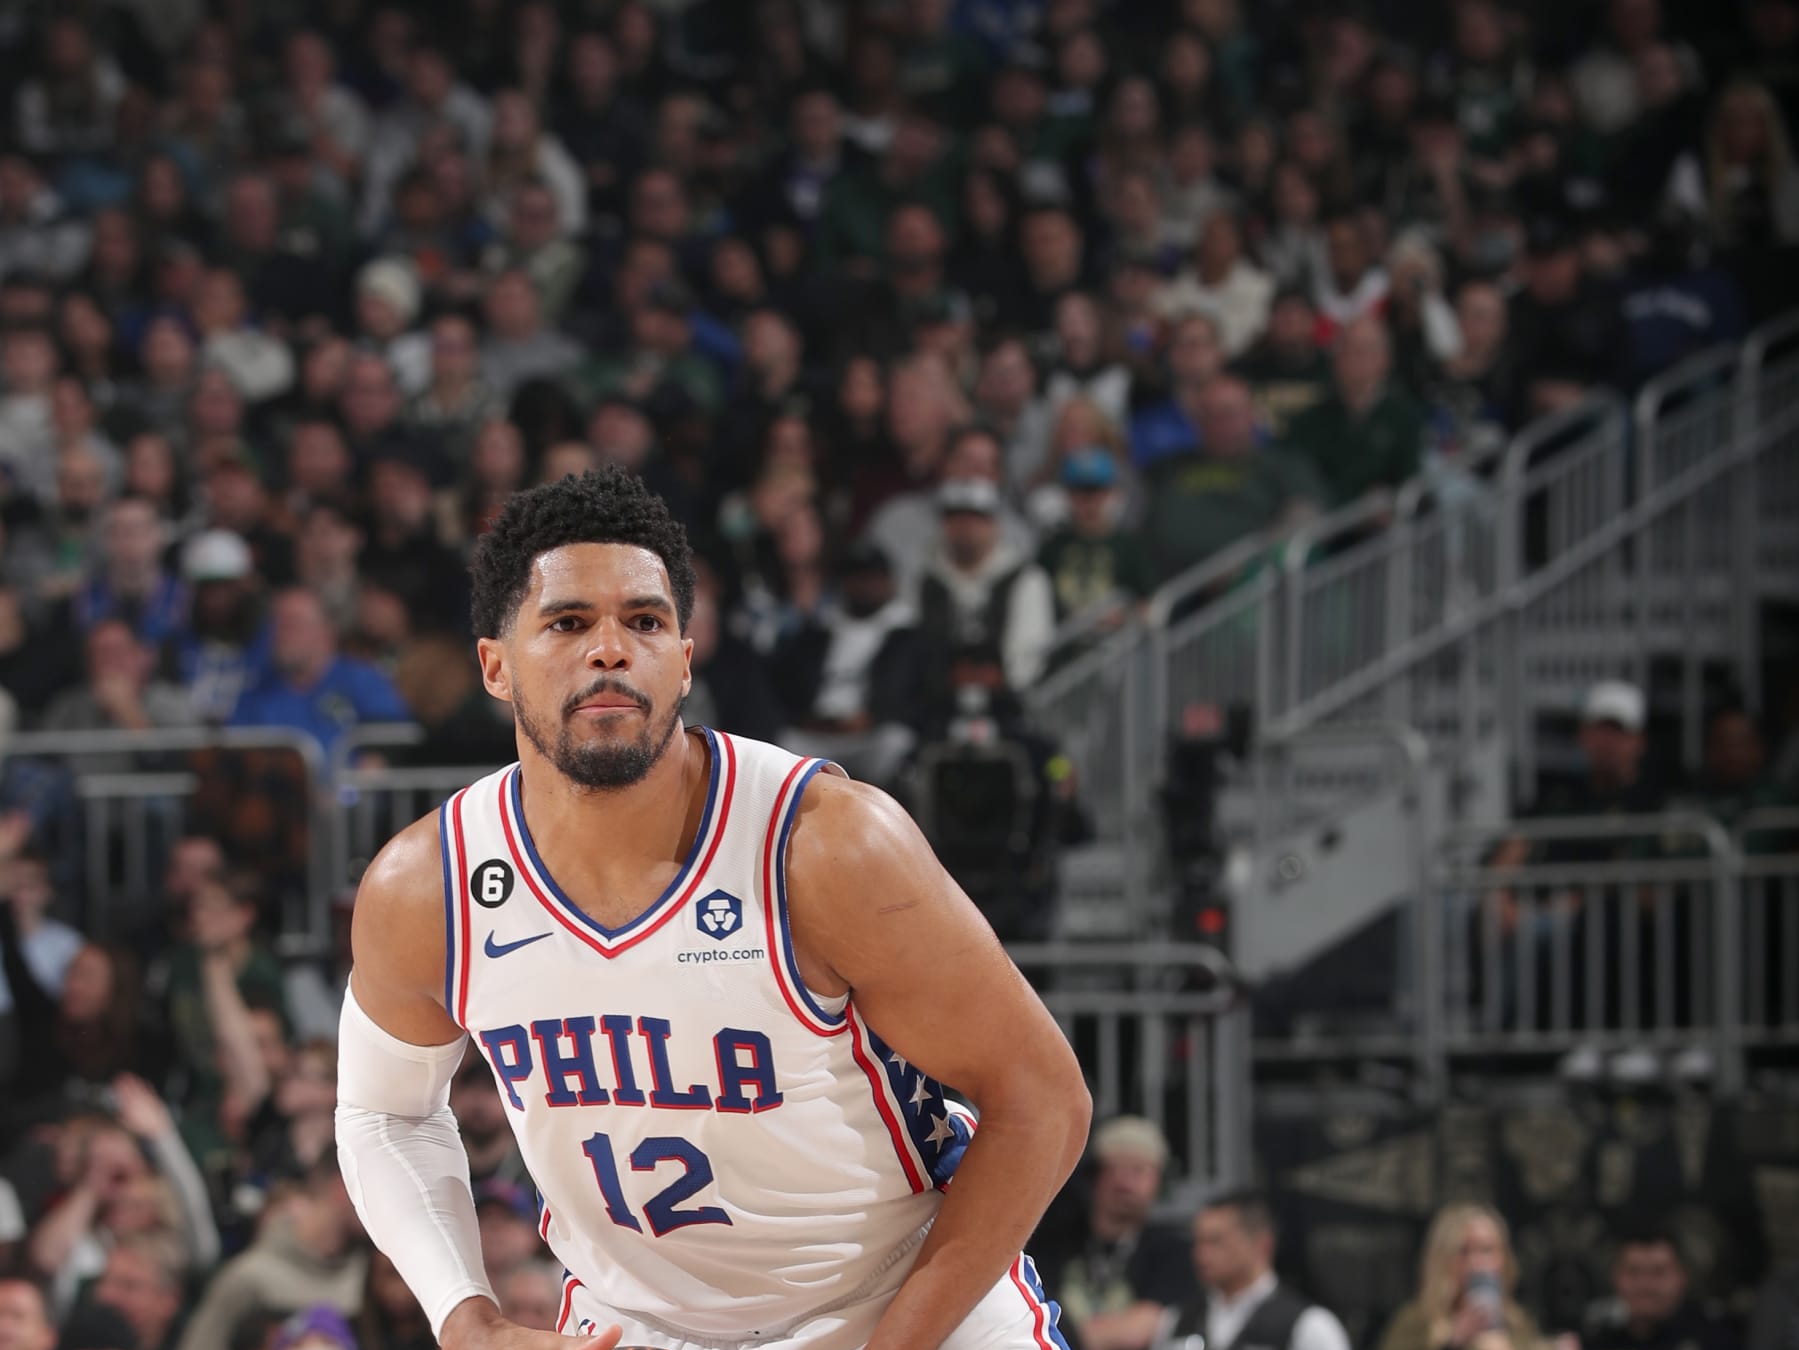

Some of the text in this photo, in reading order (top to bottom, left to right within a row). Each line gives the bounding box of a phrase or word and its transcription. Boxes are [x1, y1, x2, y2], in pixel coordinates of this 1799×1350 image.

[482, 866, 505, 902] 6
[677, 948, 765, 963] crypto.com
[480, 1014, 784, 1113] PHILA
[582, 1132, 733, 1238] 12
